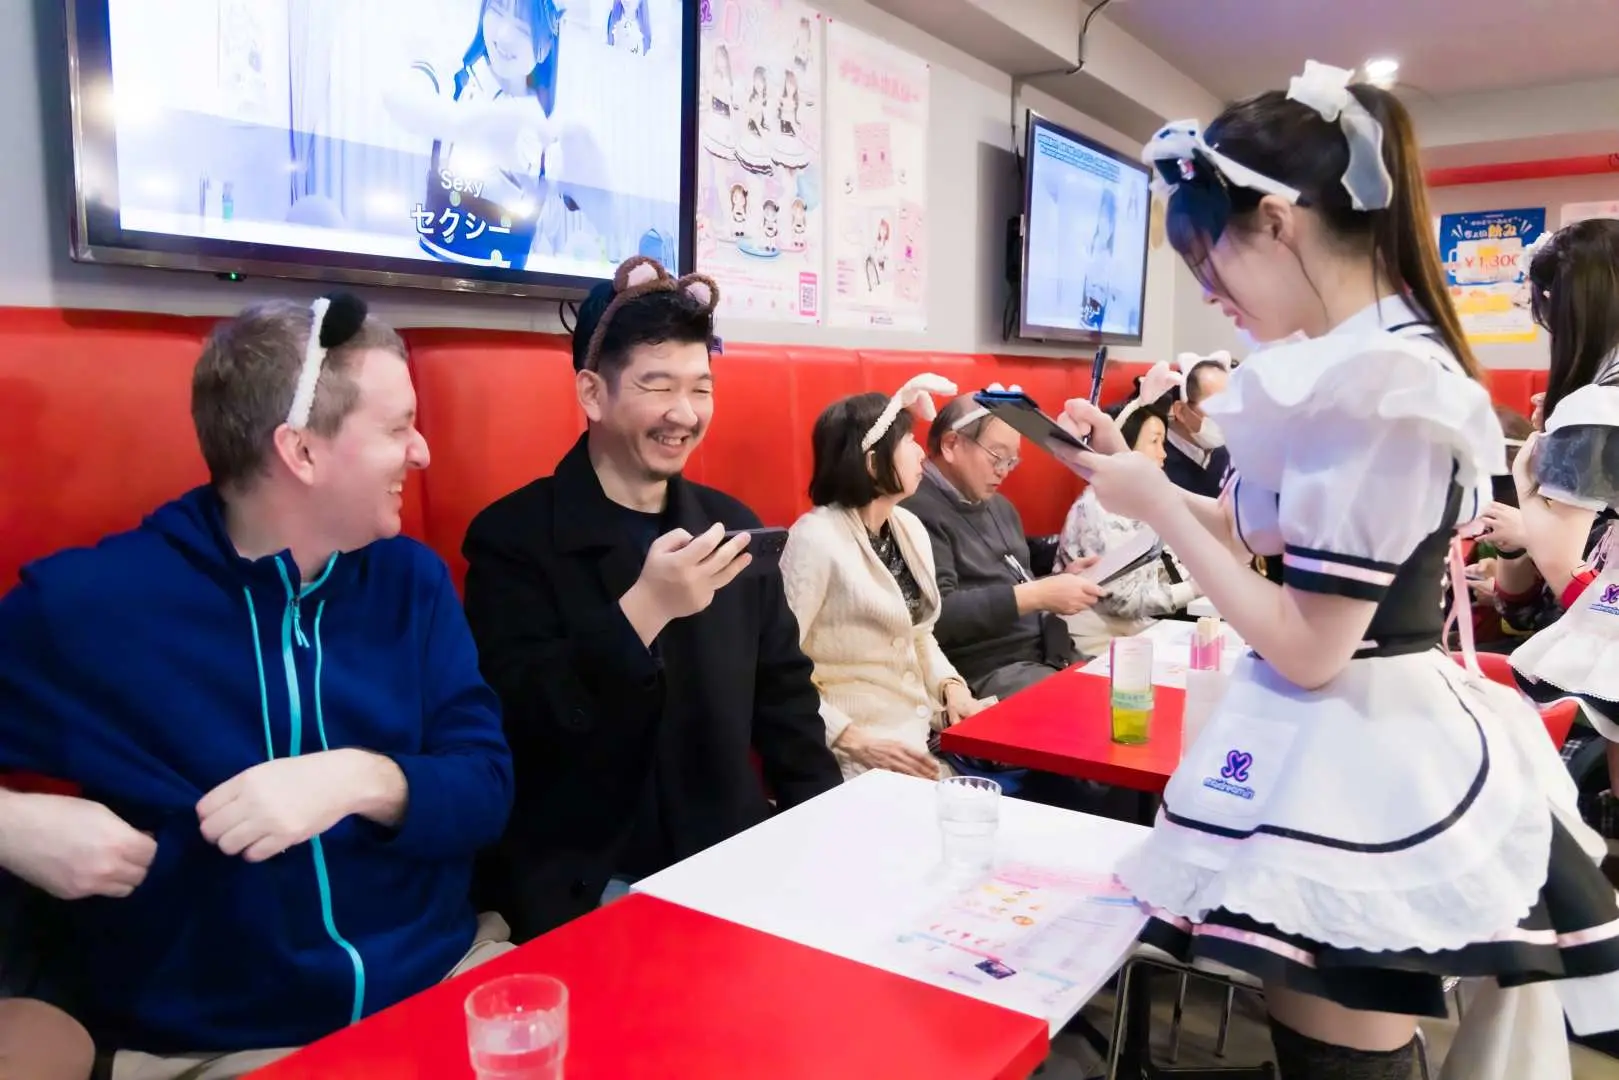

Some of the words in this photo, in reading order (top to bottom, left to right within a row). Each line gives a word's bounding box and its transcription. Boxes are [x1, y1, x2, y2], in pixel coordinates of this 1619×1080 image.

[440, 169, 484, 198] Sexy
[411, 203, 511, 240] セクシー
